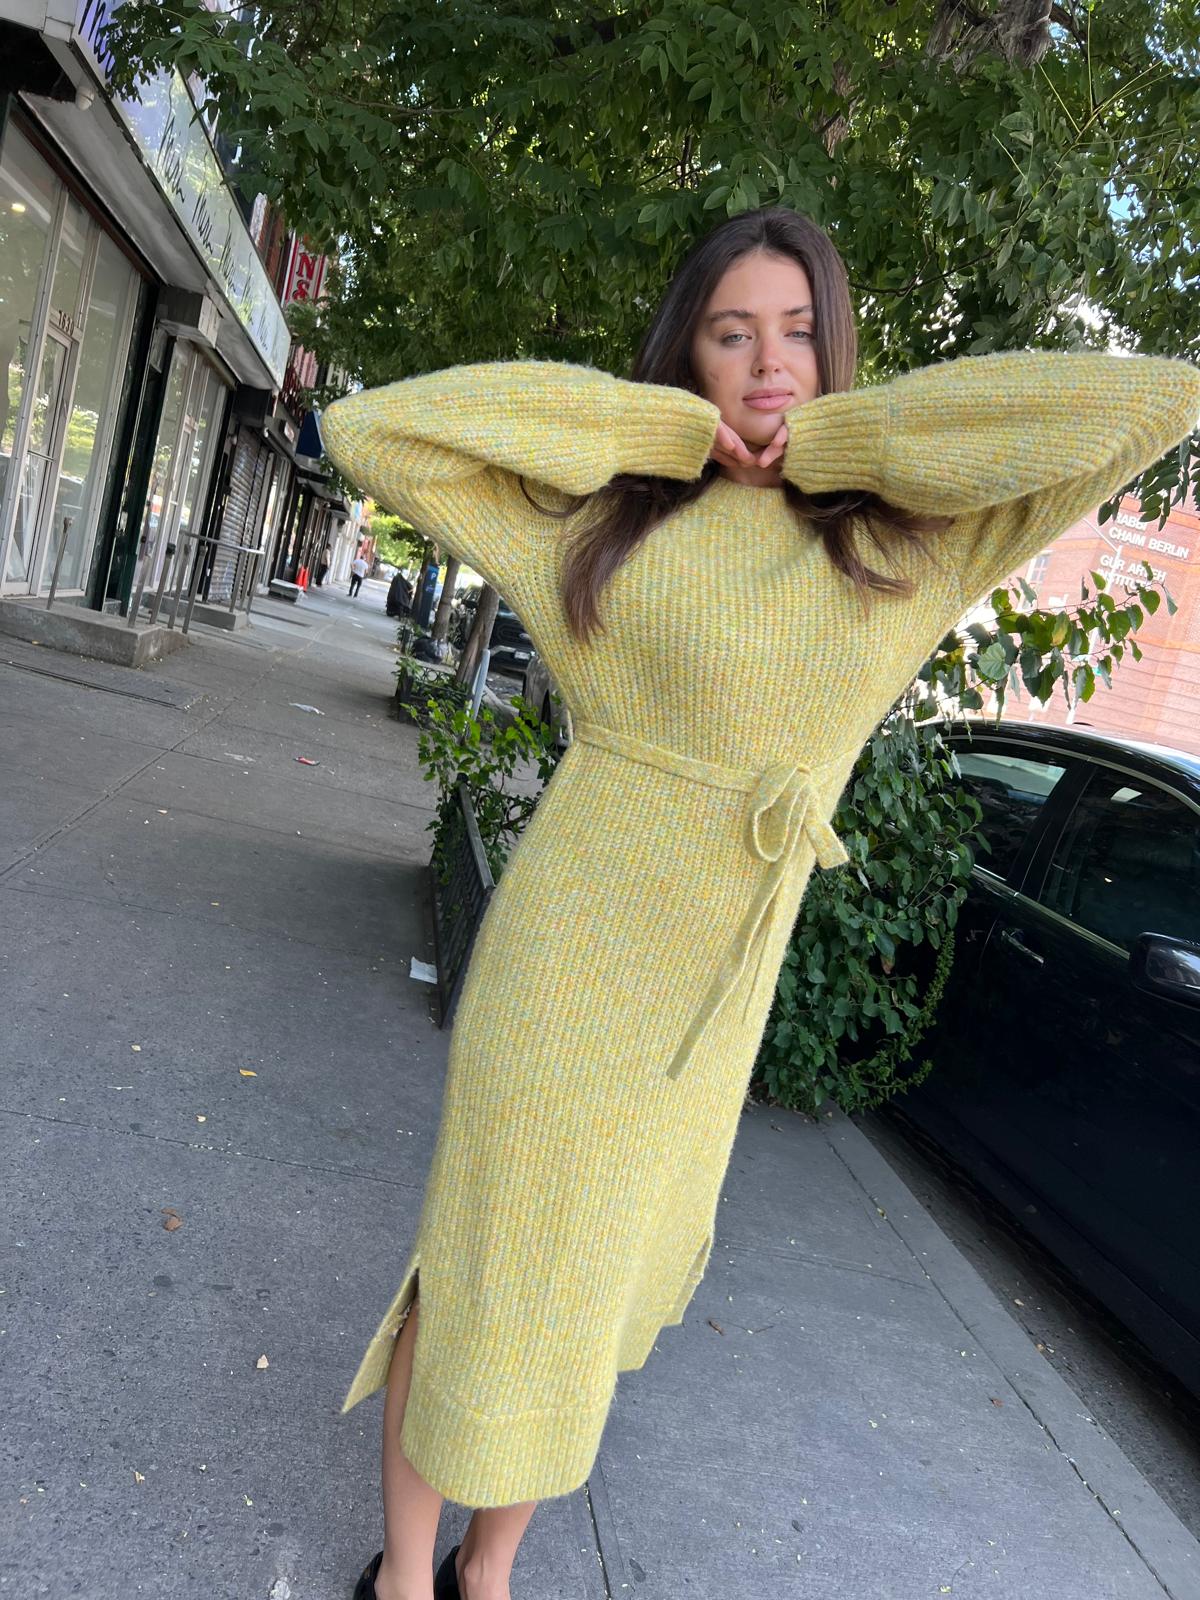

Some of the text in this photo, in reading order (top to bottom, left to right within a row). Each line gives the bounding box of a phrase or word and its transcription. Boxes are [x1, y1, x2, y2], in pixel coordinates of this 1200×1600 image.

[1108, 526, 1189, 559] CHAIM BERLIN
[1100, 554, 1166, 582] GUR AREH
